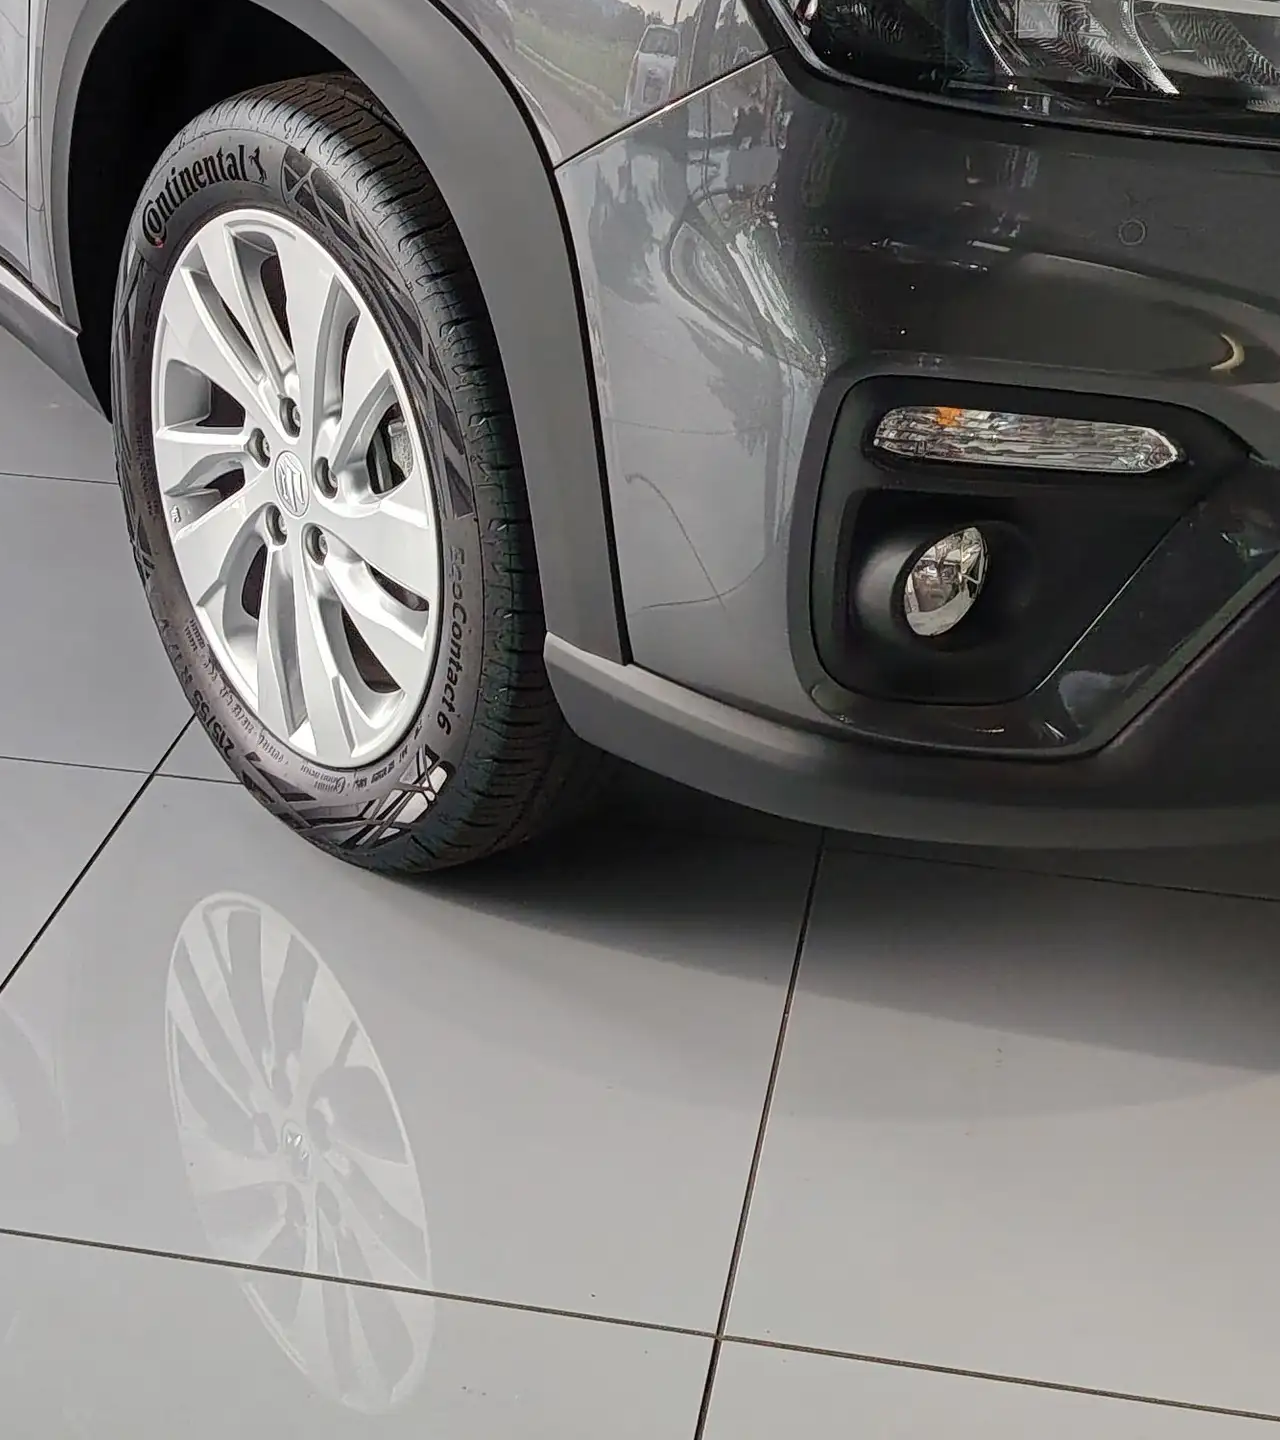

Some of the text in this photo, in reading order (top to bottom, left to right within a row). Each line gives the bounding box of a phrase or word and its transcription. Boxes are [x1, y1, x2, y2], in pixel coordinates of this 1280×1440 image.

[142, 144, 250, 248] Continental
[438, 546, 467, 736] EcoContact 6
[192, 690, 235, 760] 215/55
